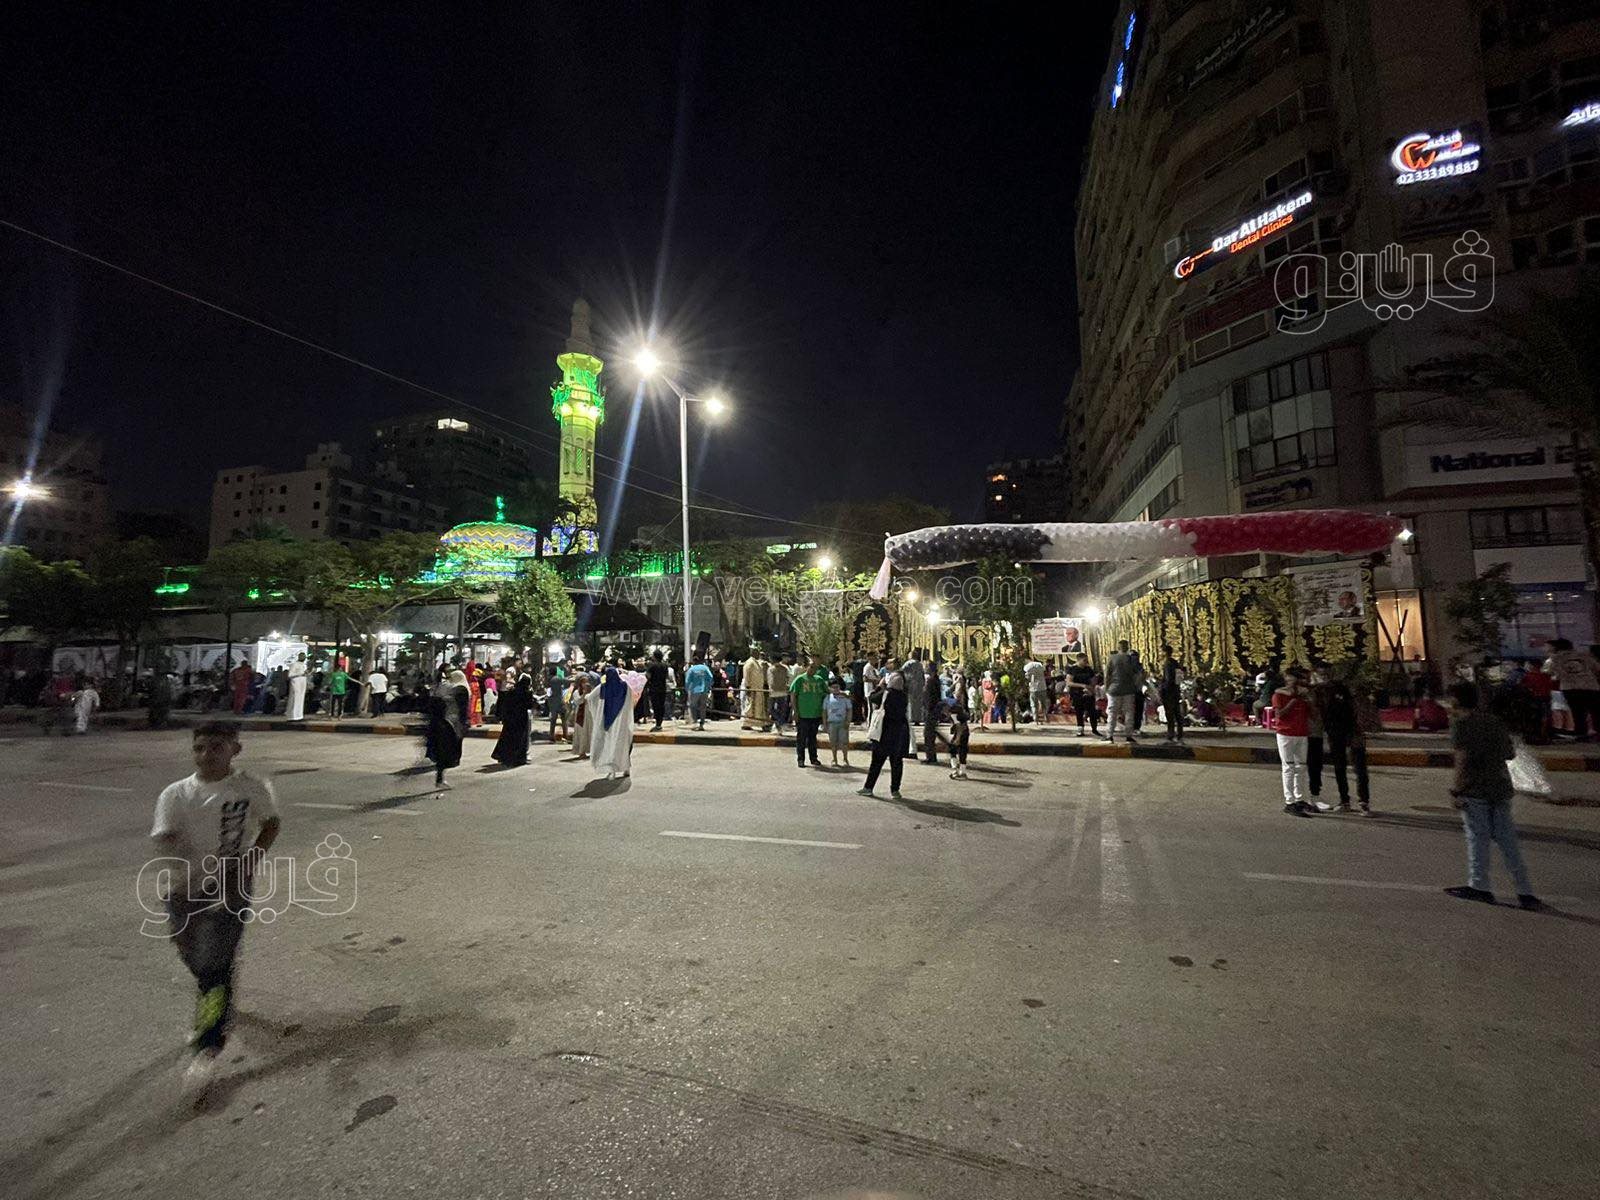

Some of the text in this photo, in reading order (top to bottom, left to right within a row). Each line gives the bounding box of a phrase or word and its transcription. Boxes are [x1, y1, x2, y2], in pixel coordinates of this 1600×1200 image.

[1212, 191, 1312, 252] Dar Al Hakem
[1230, 214, 1293, 253] Dental Clinics
[1430, 447, 1546, 473] National
